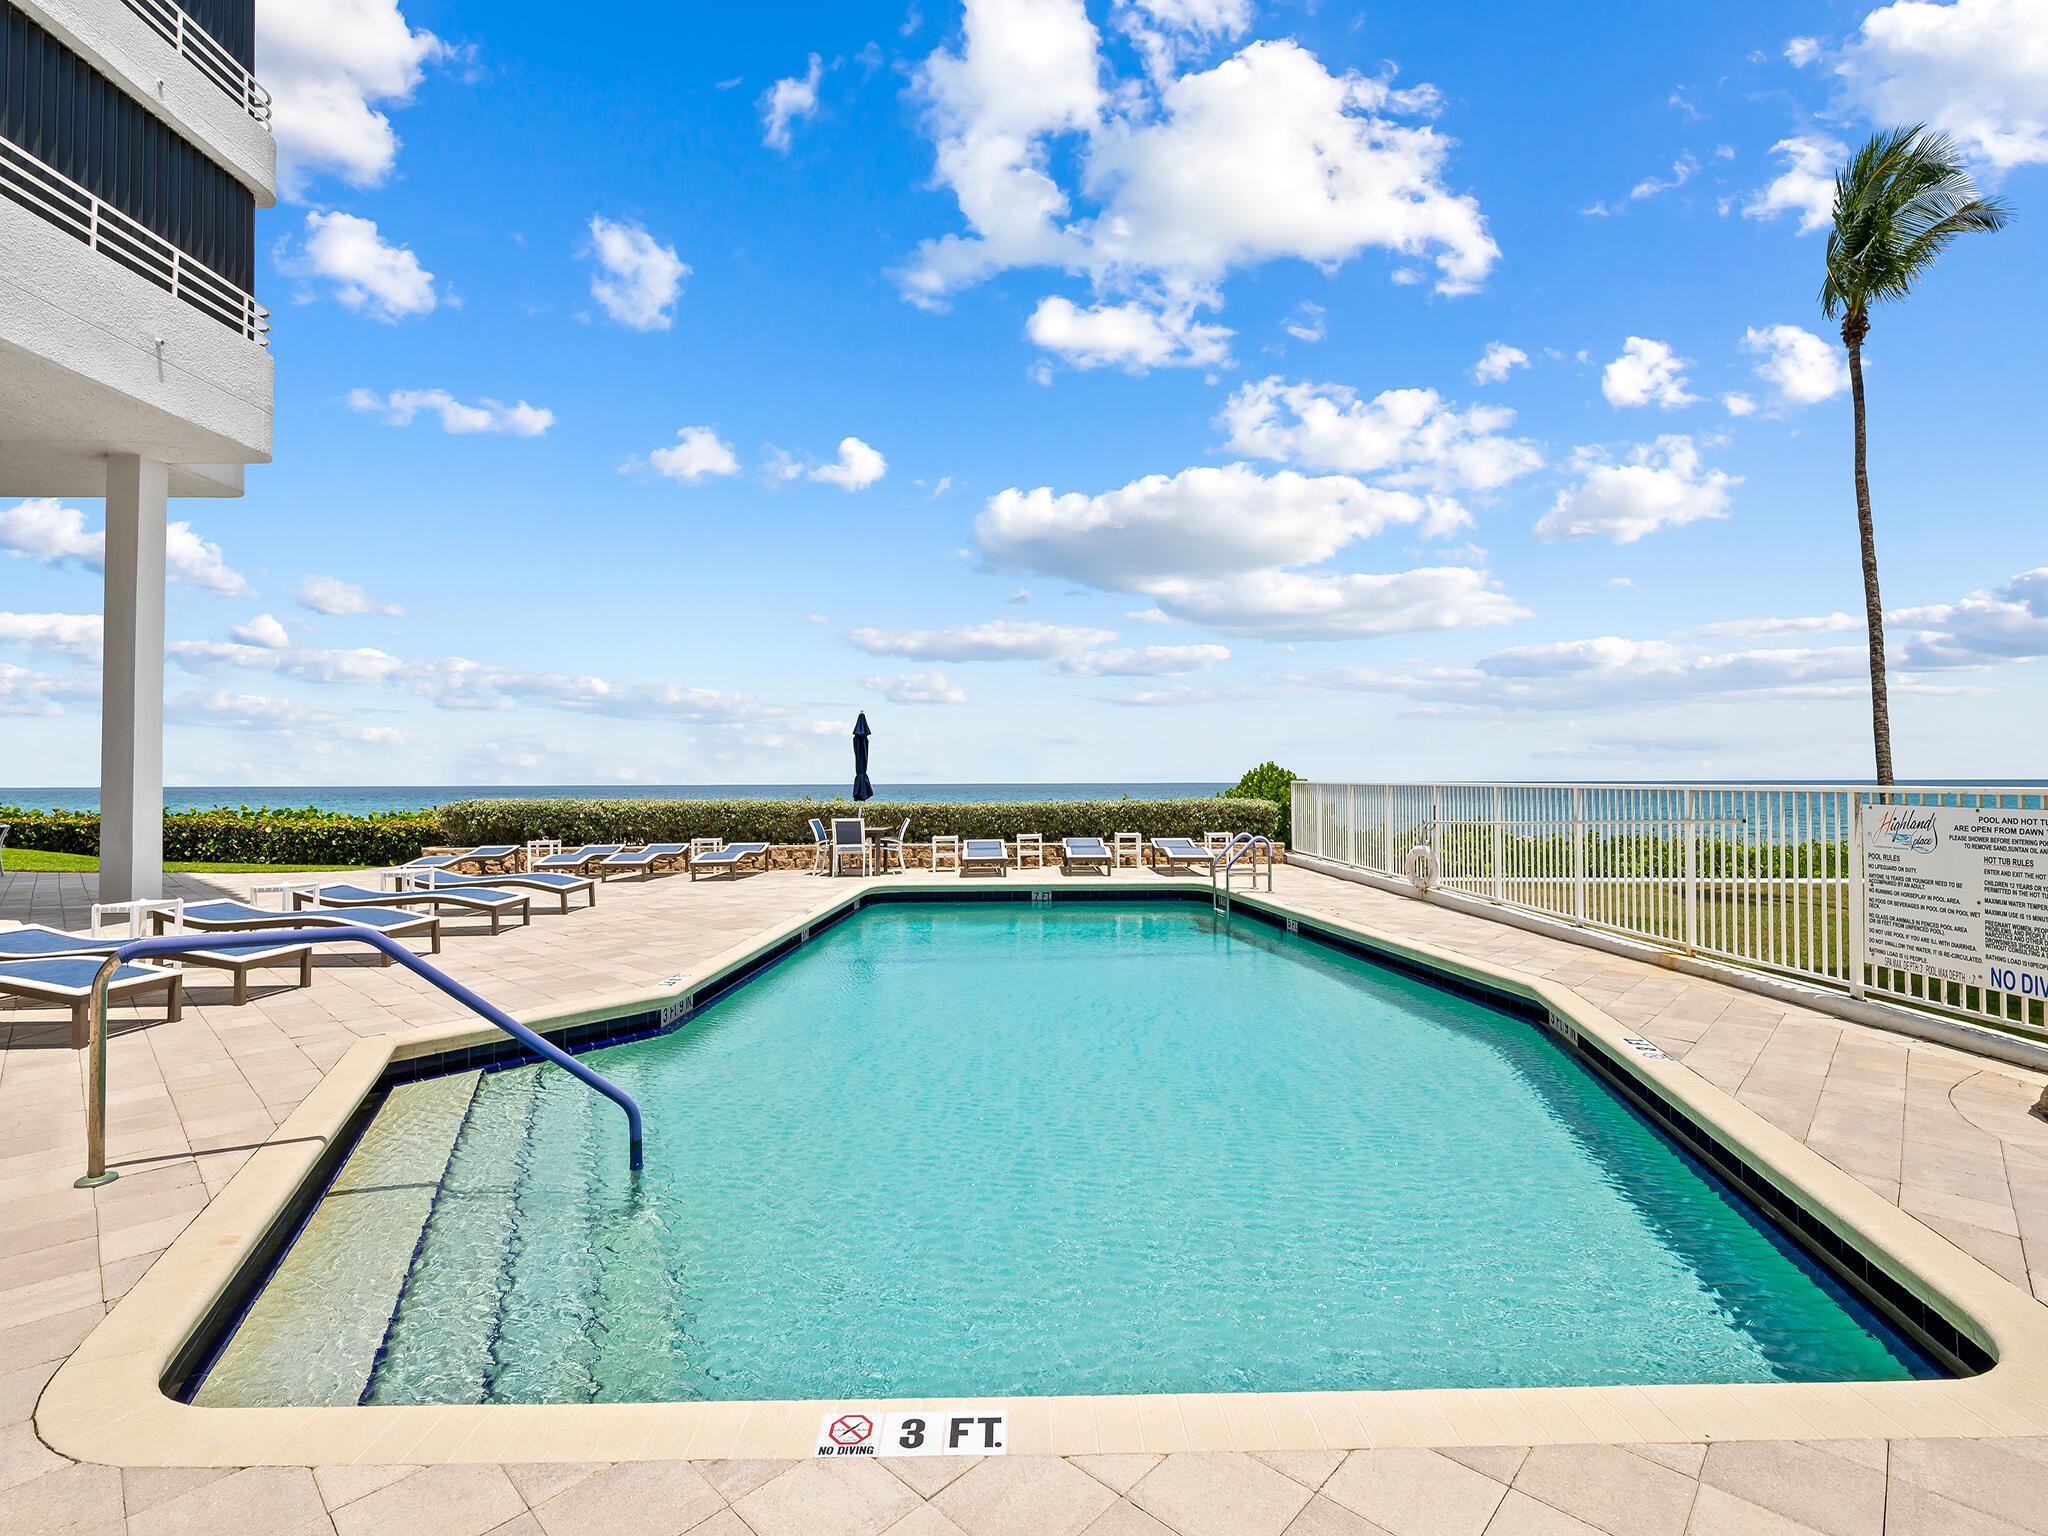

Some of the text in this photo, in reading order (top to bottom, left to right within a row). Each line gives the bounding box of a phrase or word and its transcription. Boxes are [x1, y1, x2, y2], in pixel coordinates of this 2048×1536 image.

[1872, 808, 1938, 844] Highlands
[2012, 859, 2034, 867] RULES
[1984, 887, 2011, 895] PERMITTED
[1894, 901, 1919, 909] BEVERAGES
[1905, 924, 1929, 932] UNFENCED
[1985, 920, 2011, 928] PREGNANT
[1985, 931, 2012, 940] NARCOTICS
[2026, 931, 2045, 940] PEOPLE
[1884, 940, 1905, 948] SWALLOW
[1985, 937, 2017, 947] DROWSINESS
[2018, 942, 2039, 951] SHOULD
[1869, 947, 1886, 955] BATHING
[2008, 946, 2040, 957] CONSULTING
[1985, 954, 2006, 962] BATHING
[1991, 967, 2016, 990] NO
[663, 1008, 667, 1022] 3
[900, 1418, 926, 1449] 3
[818, 1446, 874, 1455] NO DIVING
